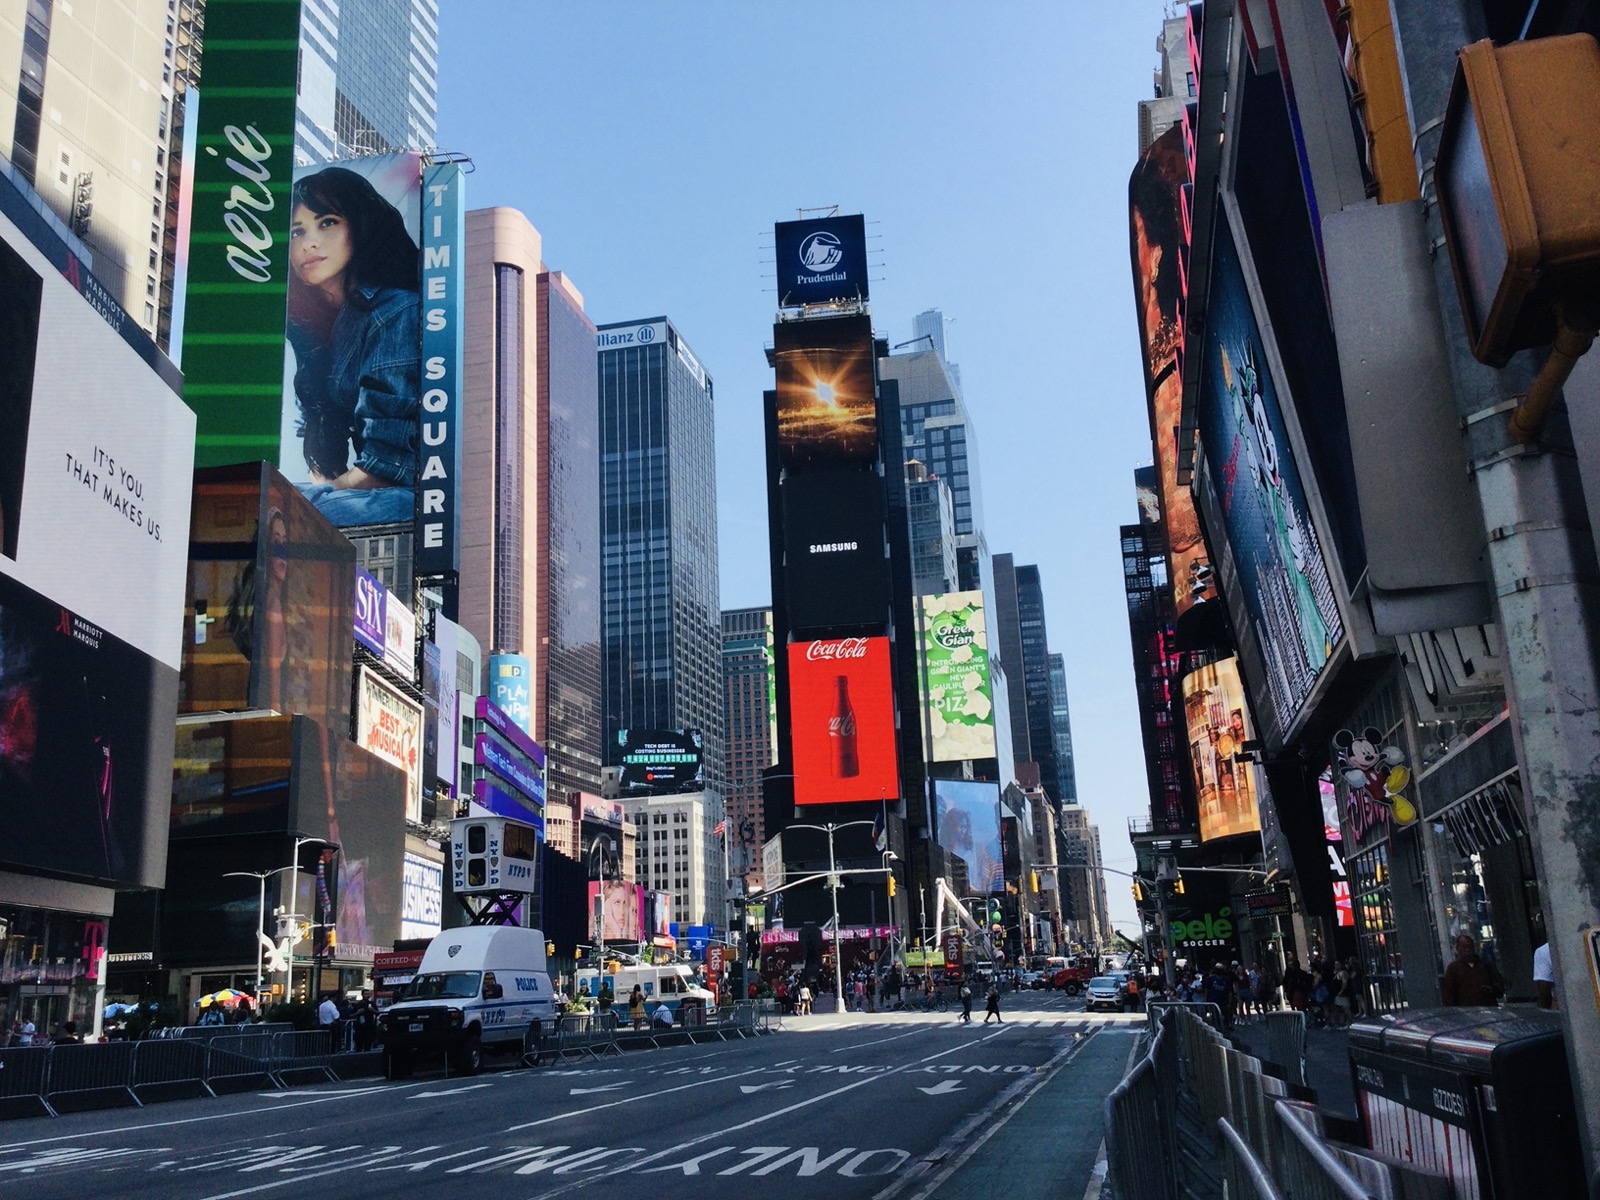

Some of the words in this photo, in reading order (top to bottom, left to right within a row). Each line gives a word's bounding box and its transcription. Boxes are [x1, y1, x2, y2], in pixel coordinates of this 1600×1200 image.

[206, 124, 275, 283] aerie
[424, 184, 451, 332] TIMES
[796, 271, 847, 285] Prudential
[85, 289, 121, 333] MARQUIS
[86, 274, 126, 323] MARRIOTT
[597, 332, 634, 347] llianz
[421, 355, 448, 548] SQUARE
[93, 445, 115, 477] IT'S
[120, 466, 144, 502] YOU.
[66, 452, 99, 493] THAT
[102, 483, 143, 527] MAKES
[147, 517, 162, 543] US.
[809, 541, 858, 554] SAMSUNG
[73, 629, 99, 649] MARQUIS
[74, 618, 103, 640] MARRIOTT
[942, 634, 973, 647] Gian
[806, 636, 870, 662] Coca-Cola
[931, 655, 984, 667] INTROING
[497, 684, 529, 702] PLAY
[379, 708, 401, 737] BEST
[370, 724, 406, 763] MUSICAL
[454, 842, 464, 888] NYPD
[490, 839, 500, 885] NYPD
[507, 864, 526, 879] NYPD
[402, 883, 441, 925] USINESS
[1169, 906, 1233, 947] pelé
[947, 937, 959, 961] tkts
[1182, 939, 1226, 948] SOCCER
[711, 948, 721, 971] tkts
[515, 977, 538, 991] POLICE
[485, 1008, 506, 1025] NYPD
[631, 1146, 911, 1178] ONLY
